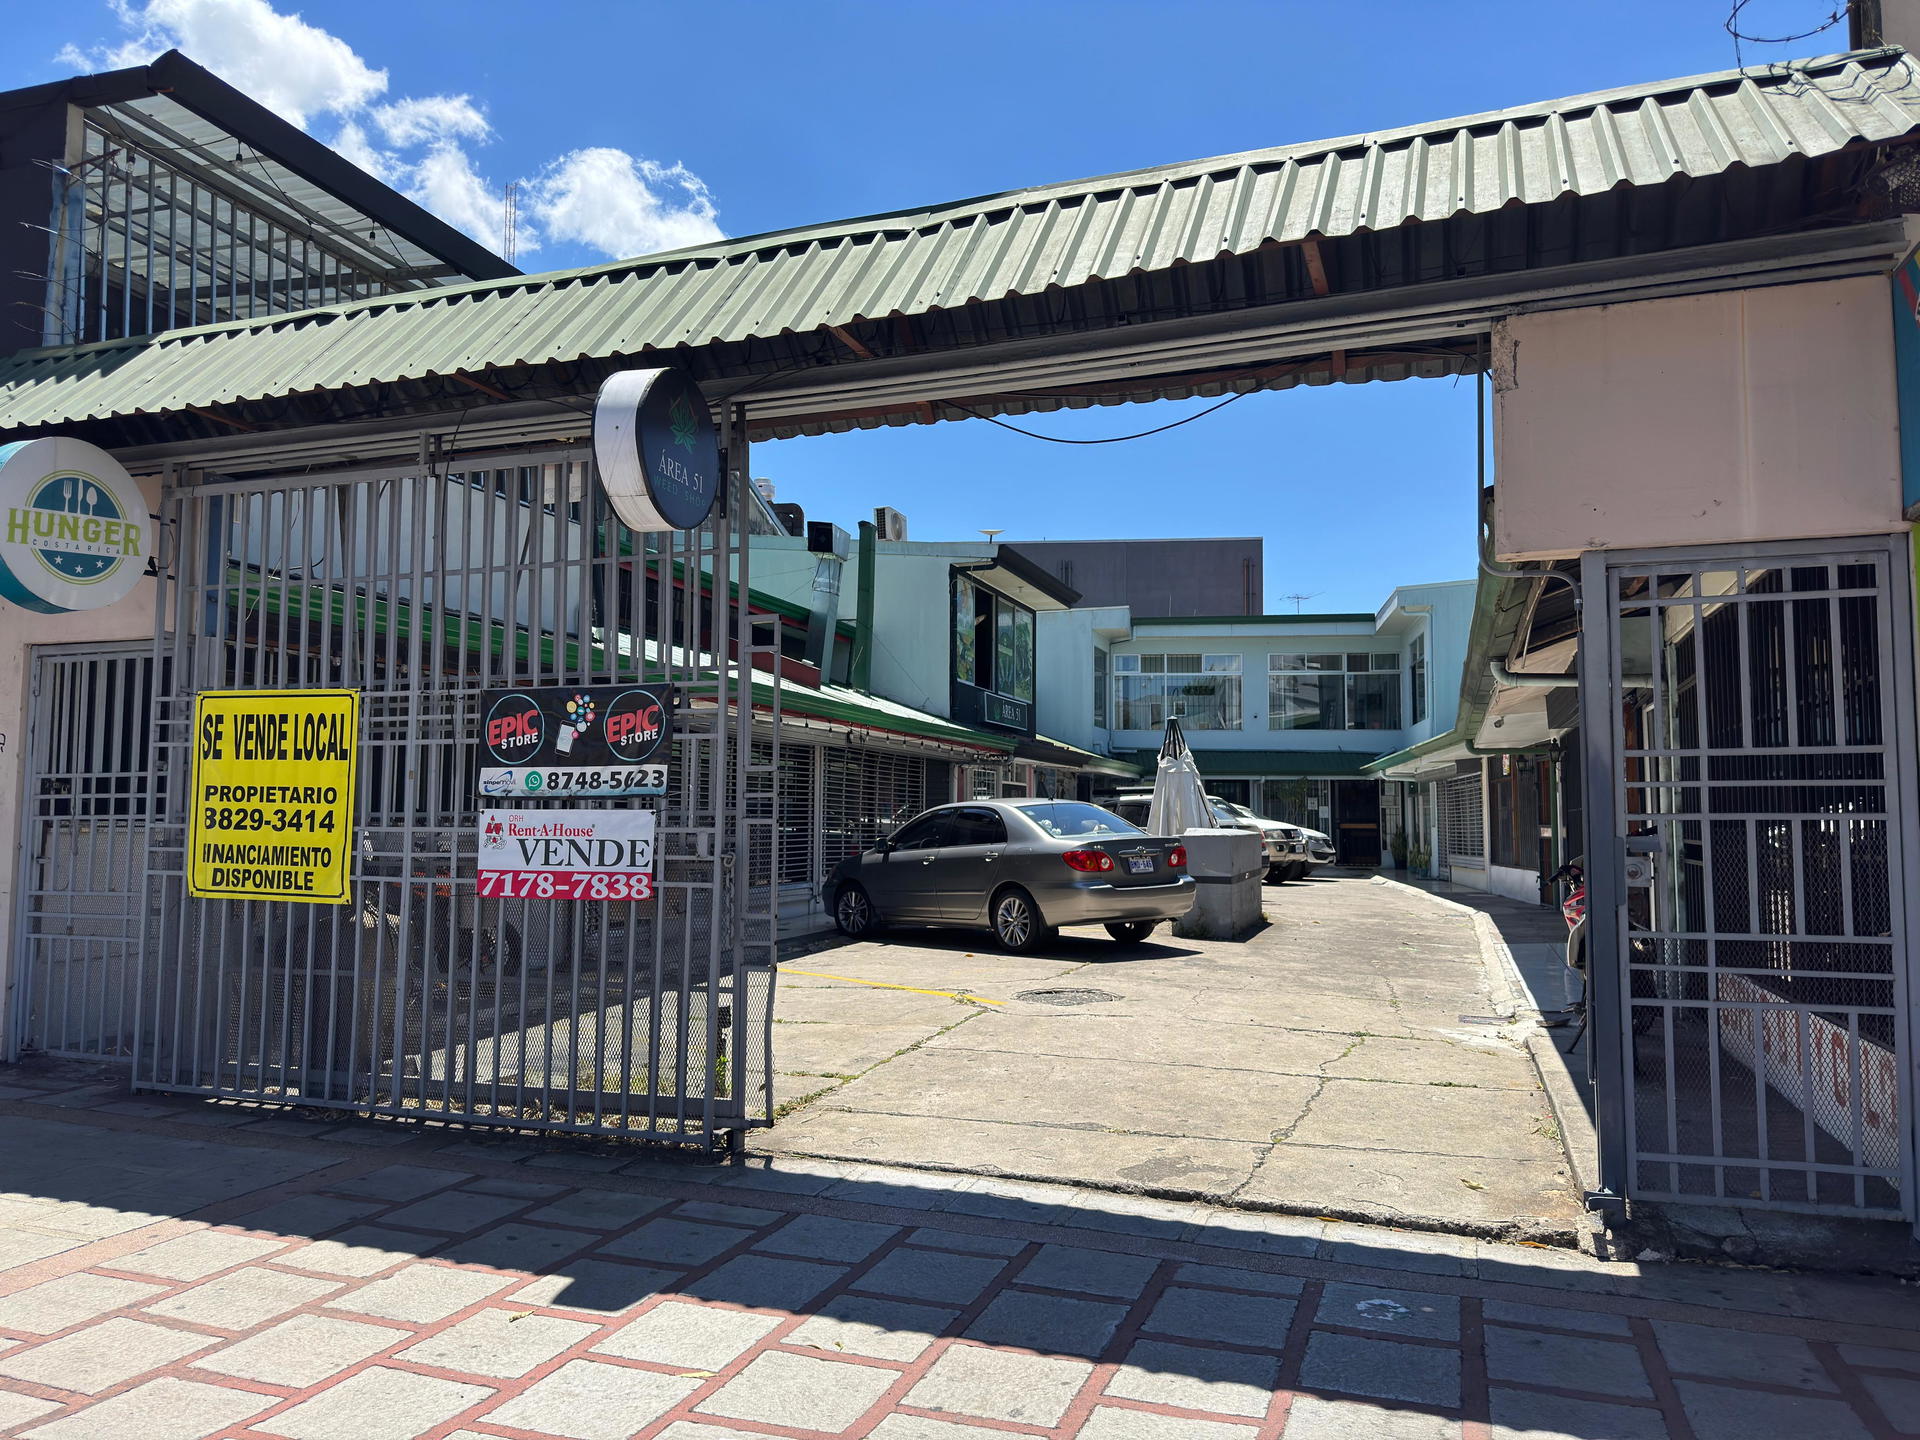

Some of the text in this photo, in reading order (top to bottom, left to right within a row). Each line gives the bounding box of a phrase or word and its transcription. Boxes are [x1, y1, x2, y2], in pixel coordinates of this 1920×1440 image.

[657, 448, 704, 494] ÁREA 51
[6, 507, 141, 557] HUNGER
[32, 538, 120, 555] COSTA RICA
[202, 712, 349, 761] SE VENDE LOCAL
[488, 709, 540, 747] EPIC
[606, 704, 660, 744] EPIC
[620, 728, 658, 747] STORE
[501, 732, 539, 750] STORE
[546, 769, 665, 792] 8748-5623
[205, 785, 337, 805] PROPIETARIO
[204, 807, 335, 833] 8829-3414
[516, 838, 650, 868] VENDE
[211, 867, 314, 891] DISPONIBLE
[480, 870, 651, 899] 7178-7838
